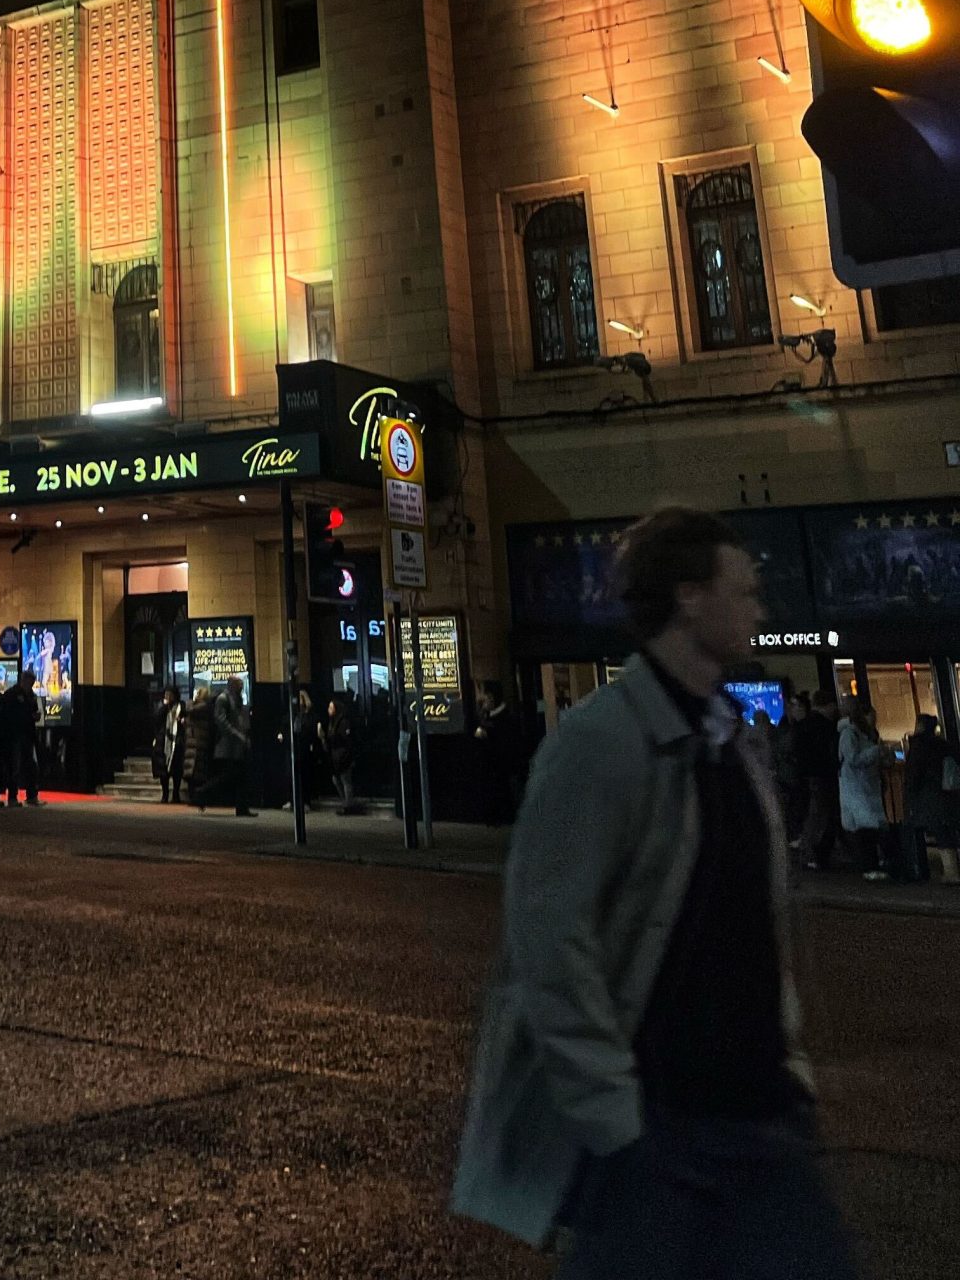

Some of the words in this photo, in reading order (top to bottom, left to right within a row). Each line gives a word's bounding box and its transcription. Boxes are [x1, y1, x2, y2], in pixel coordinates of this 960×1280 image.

[242, 438, 301, 477] Tina
[36, 466, 61, 491] 25
[65, 460, 117, 489] NOV
[120, 468, 129, 476] -
[134, 457, 146, 482] 3
[150, 451, 198, 481] JAN
[422, 620, 435, 628] CITY
[435, 619, 453, 628] LIMITS
[759, 633, 781, 646] BOX
[783, 633, 821, 646] OFFICE
[439, 650, 456, 659] BEST
